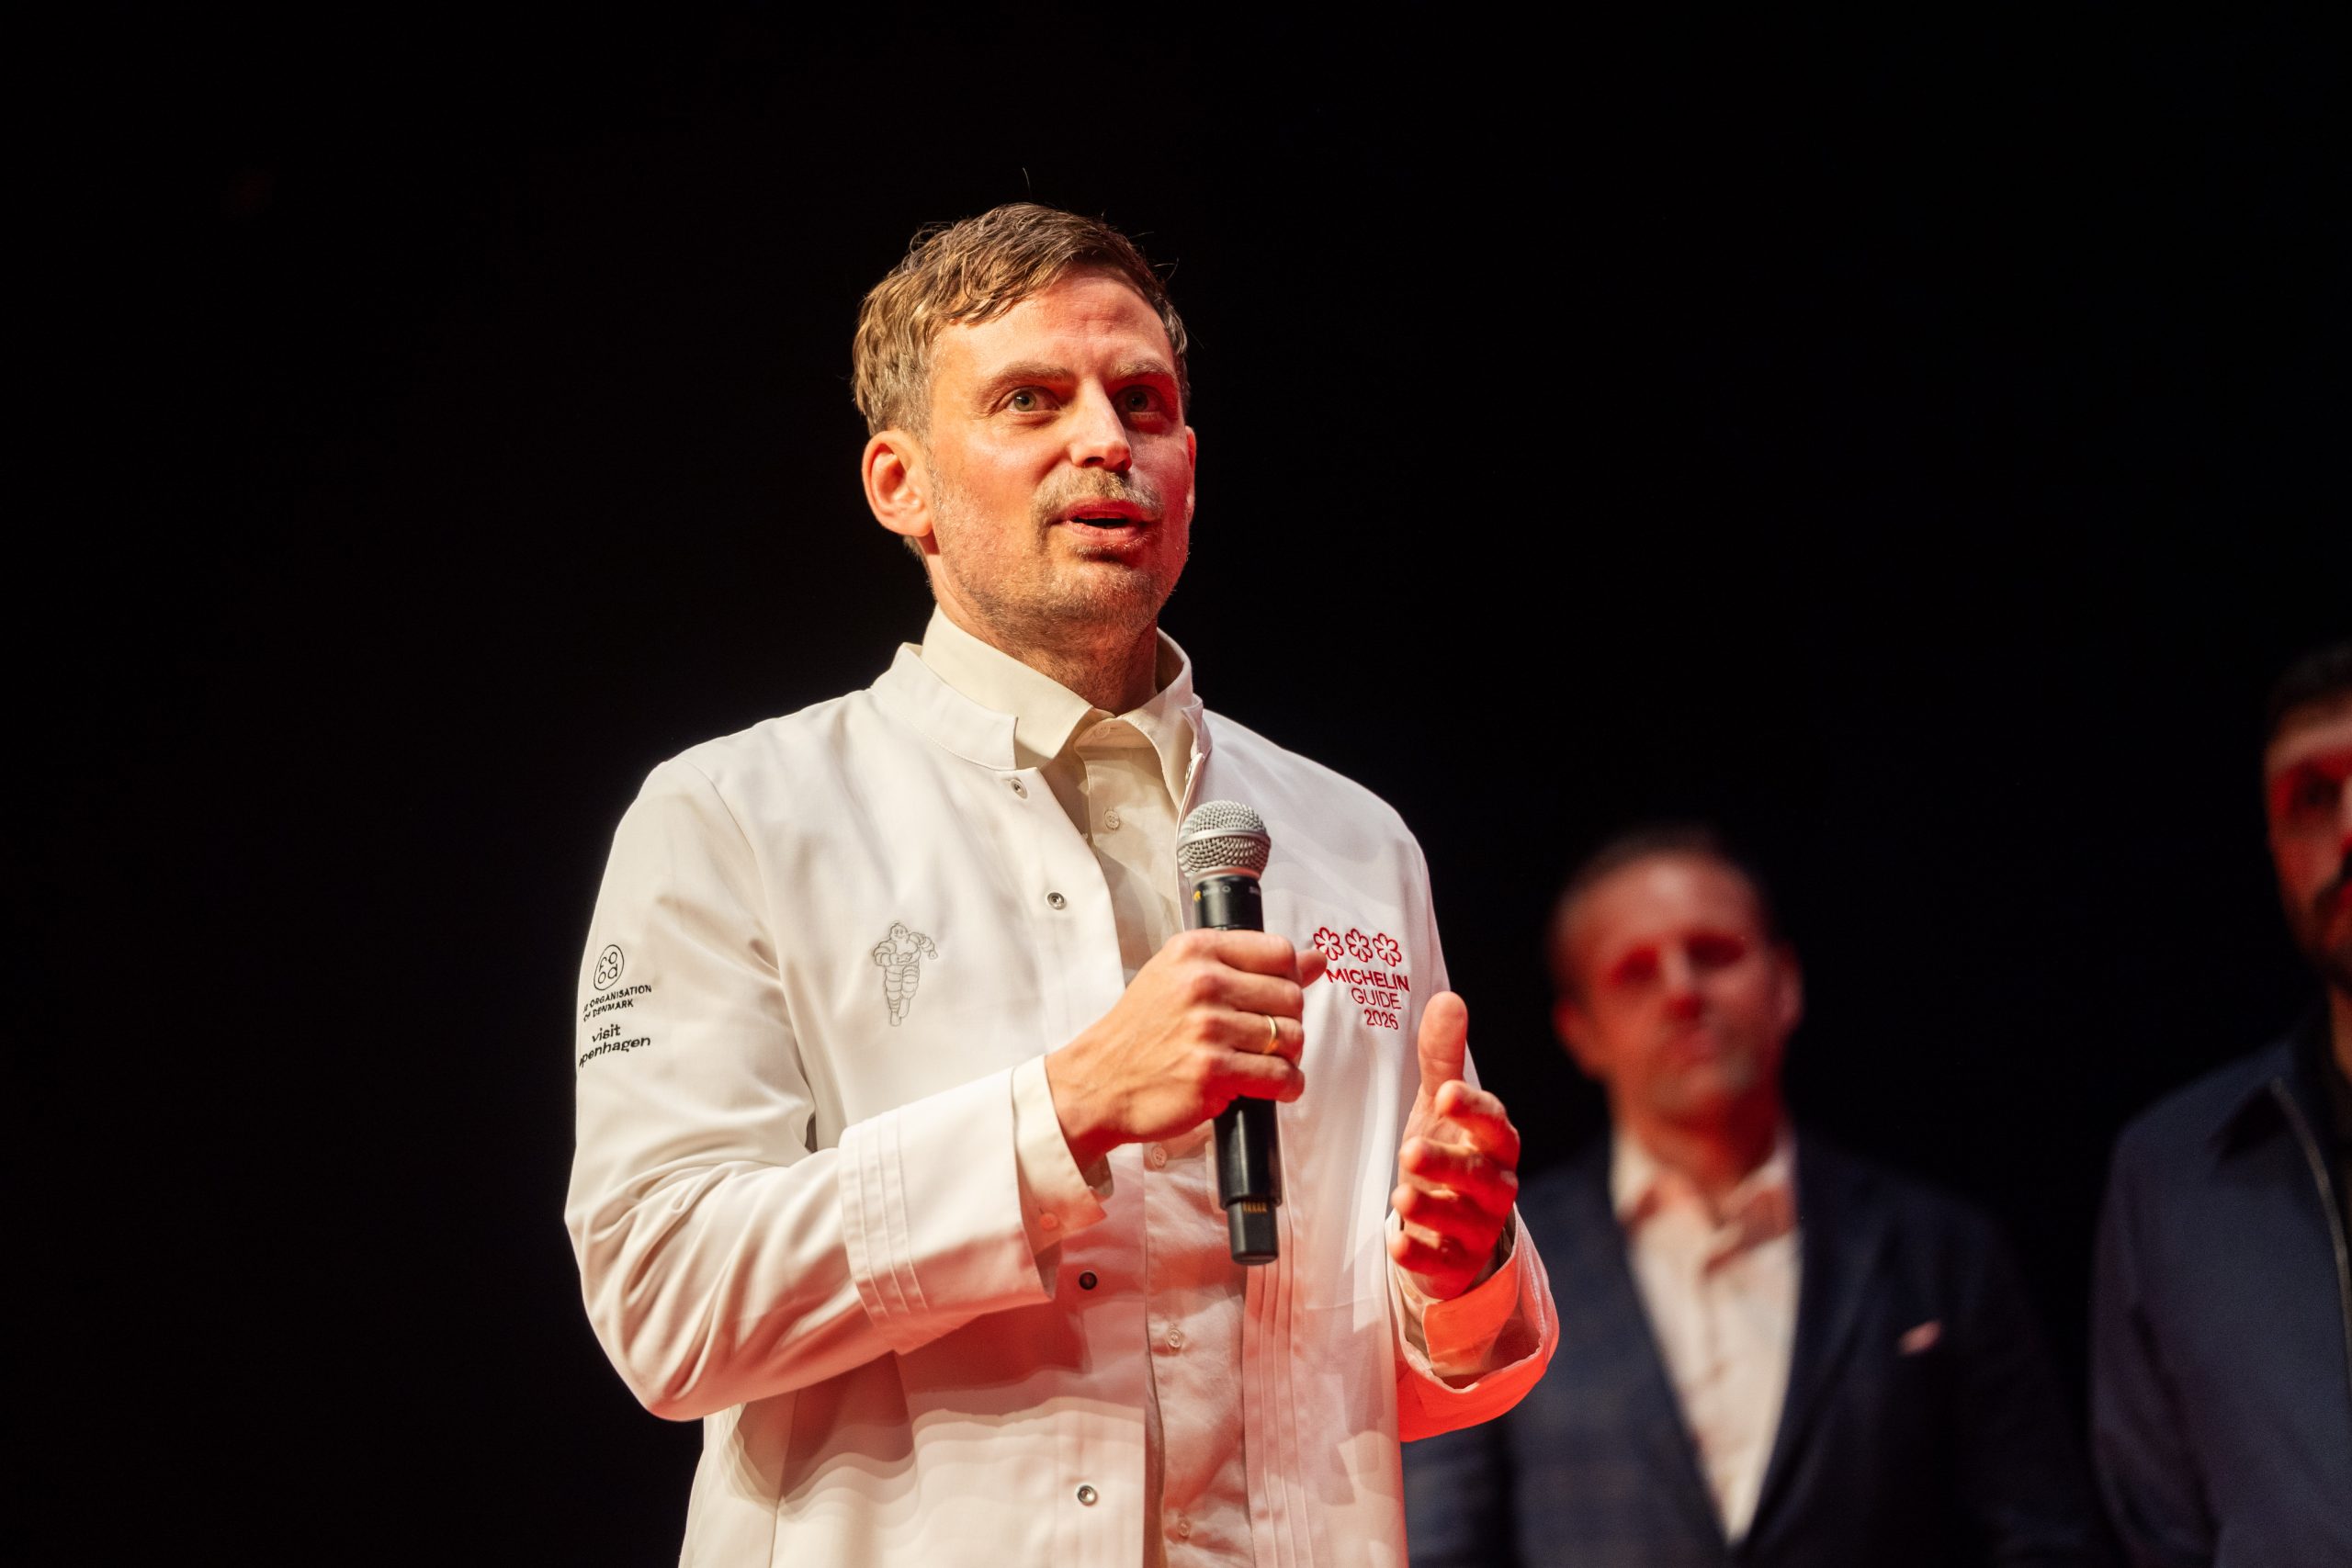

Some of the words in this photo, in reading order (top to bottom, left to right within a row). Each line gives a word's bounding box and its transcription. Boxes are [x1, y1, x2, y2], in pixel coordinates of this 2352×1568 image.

[1325, 968, 1410, 992] MICHELIN
[589, 985, 652, 1008] ORGANISATION
[593, 998, 634, 1018] DENMARK
[1351, 987, 1402, 1010] GUIDE
[1363, 1009, 1399, 1030] 2026
[592, 1023, 621, 1043] visit
[579, 1037, 651, 1067] penhagen
